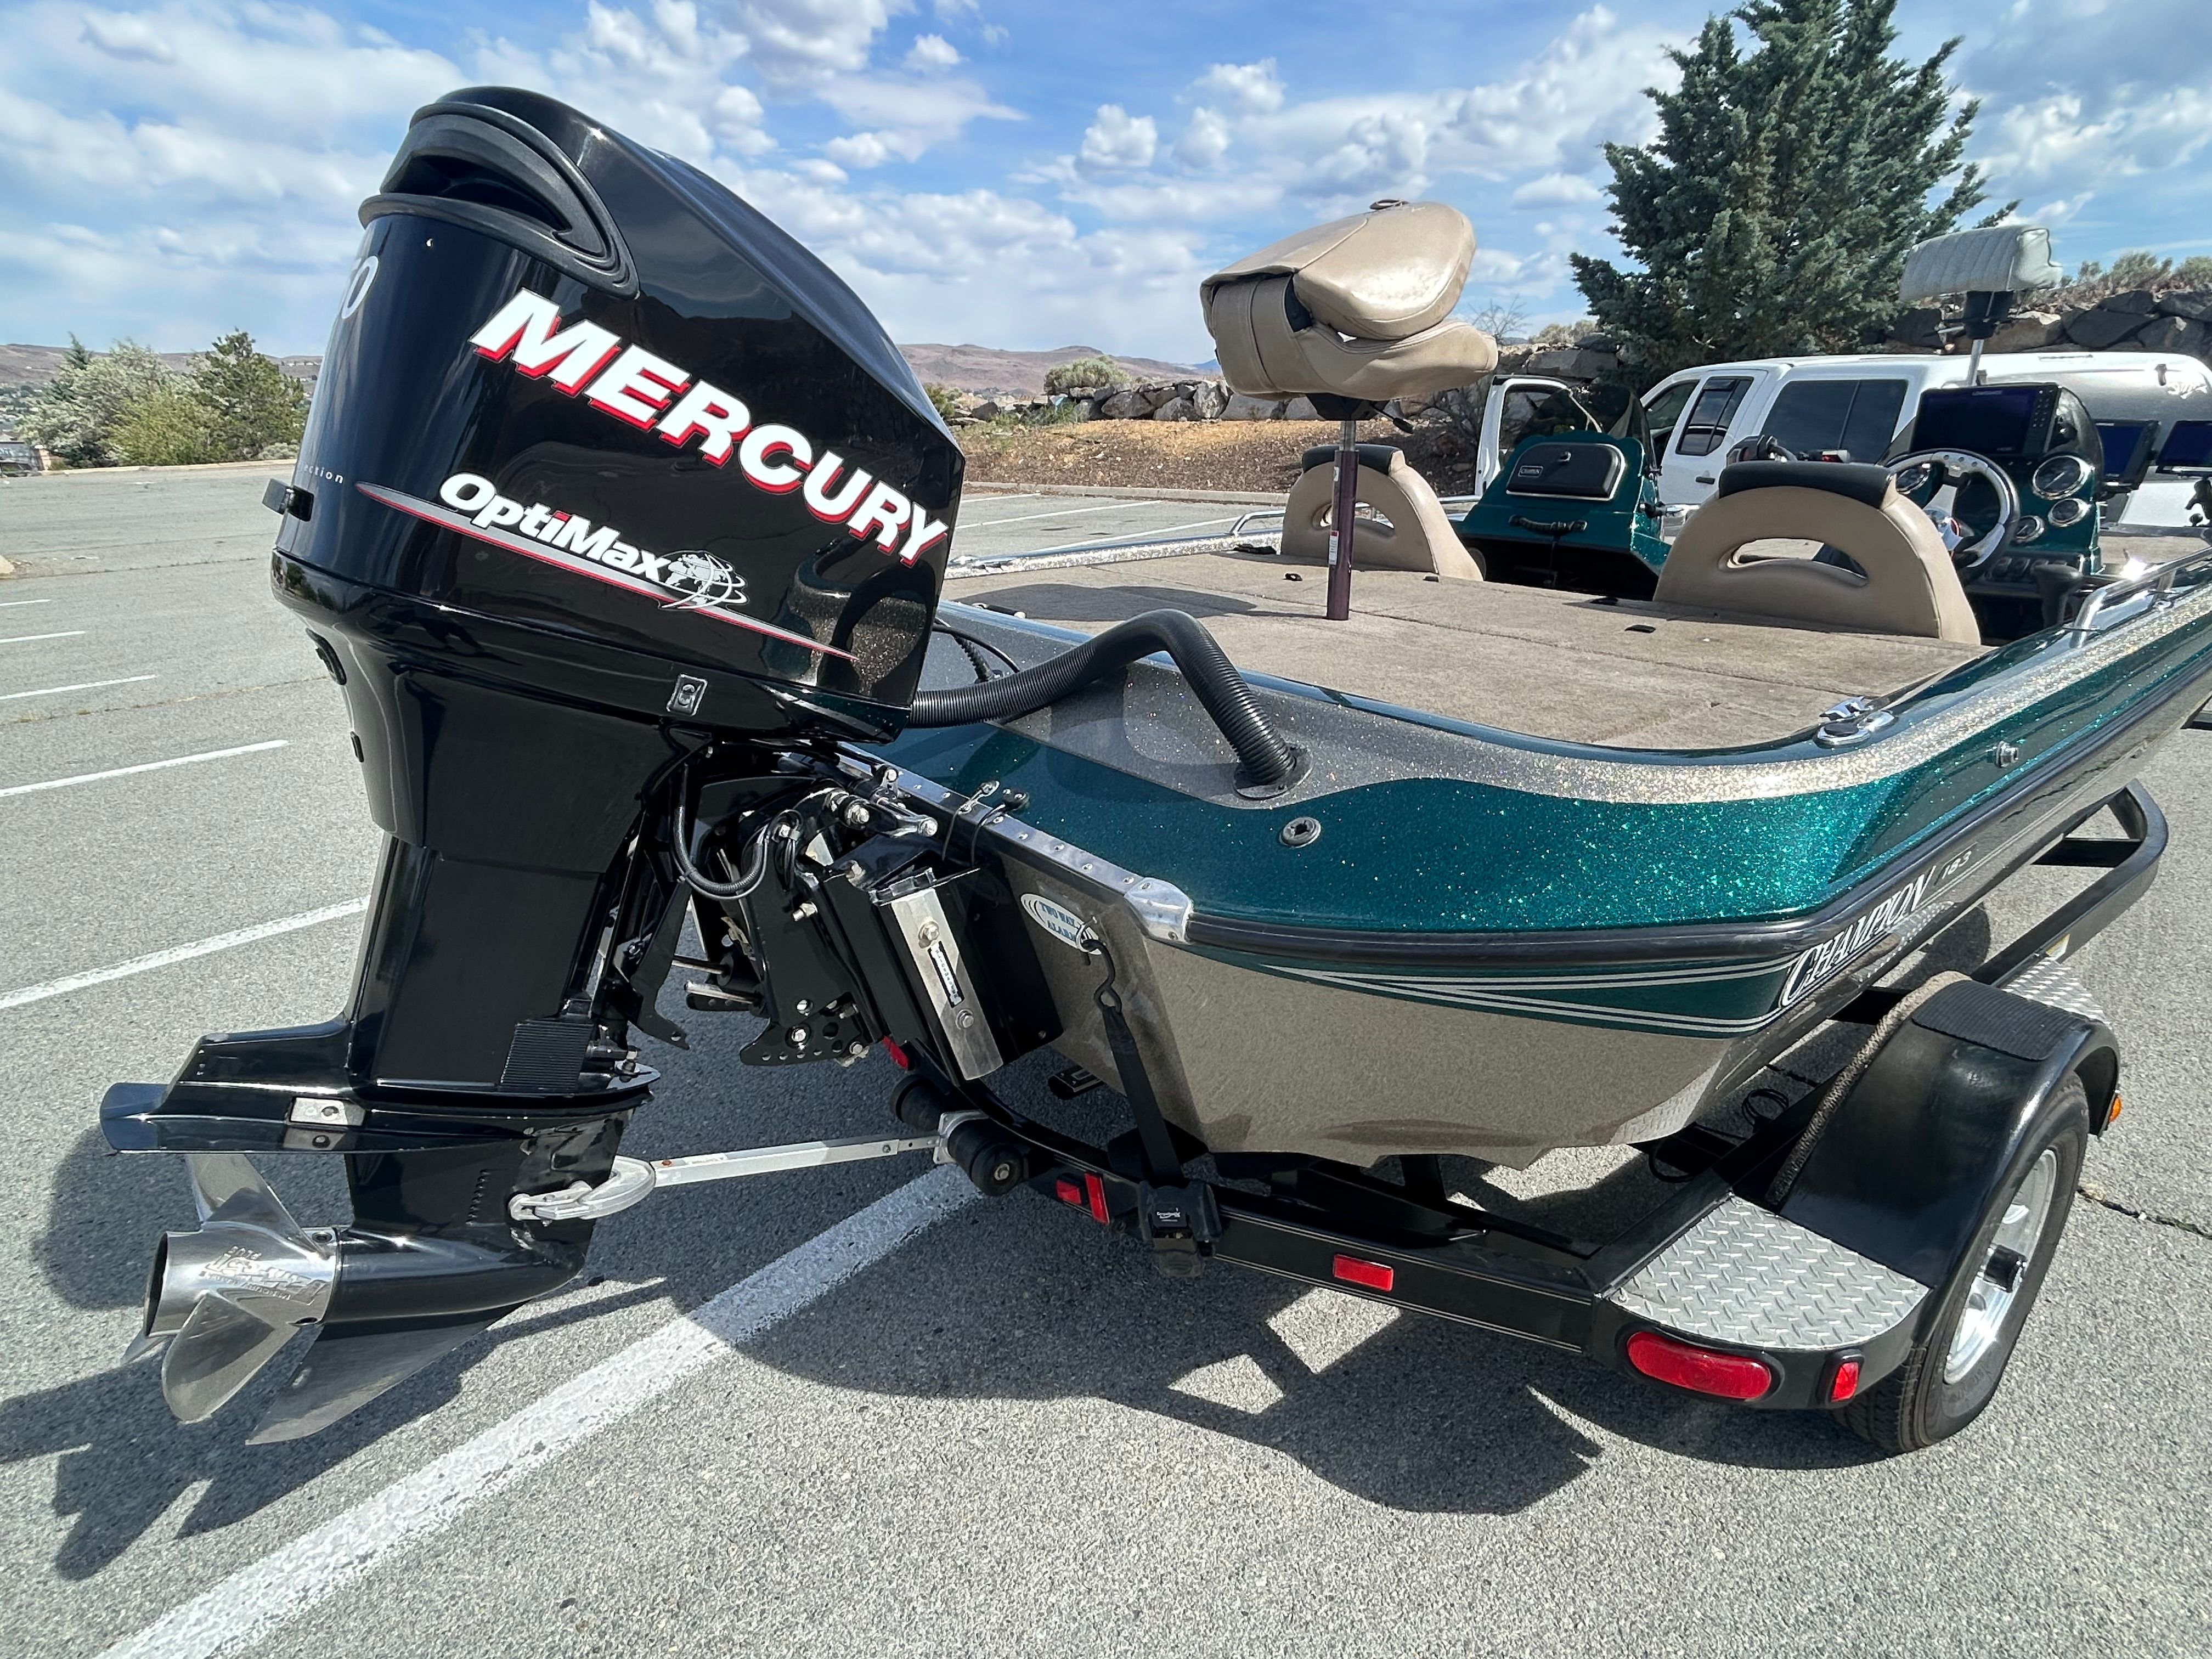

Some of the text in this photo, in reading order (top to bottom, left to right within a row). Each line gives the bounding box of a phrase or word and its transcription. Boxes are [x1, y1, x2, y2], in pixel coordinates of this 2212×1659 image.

[469, 287, 949, 568] MERCURY
[440, 472, 670, 578] OptiMax
[1782, 851, 1972, 1006] CHAMPION 183
